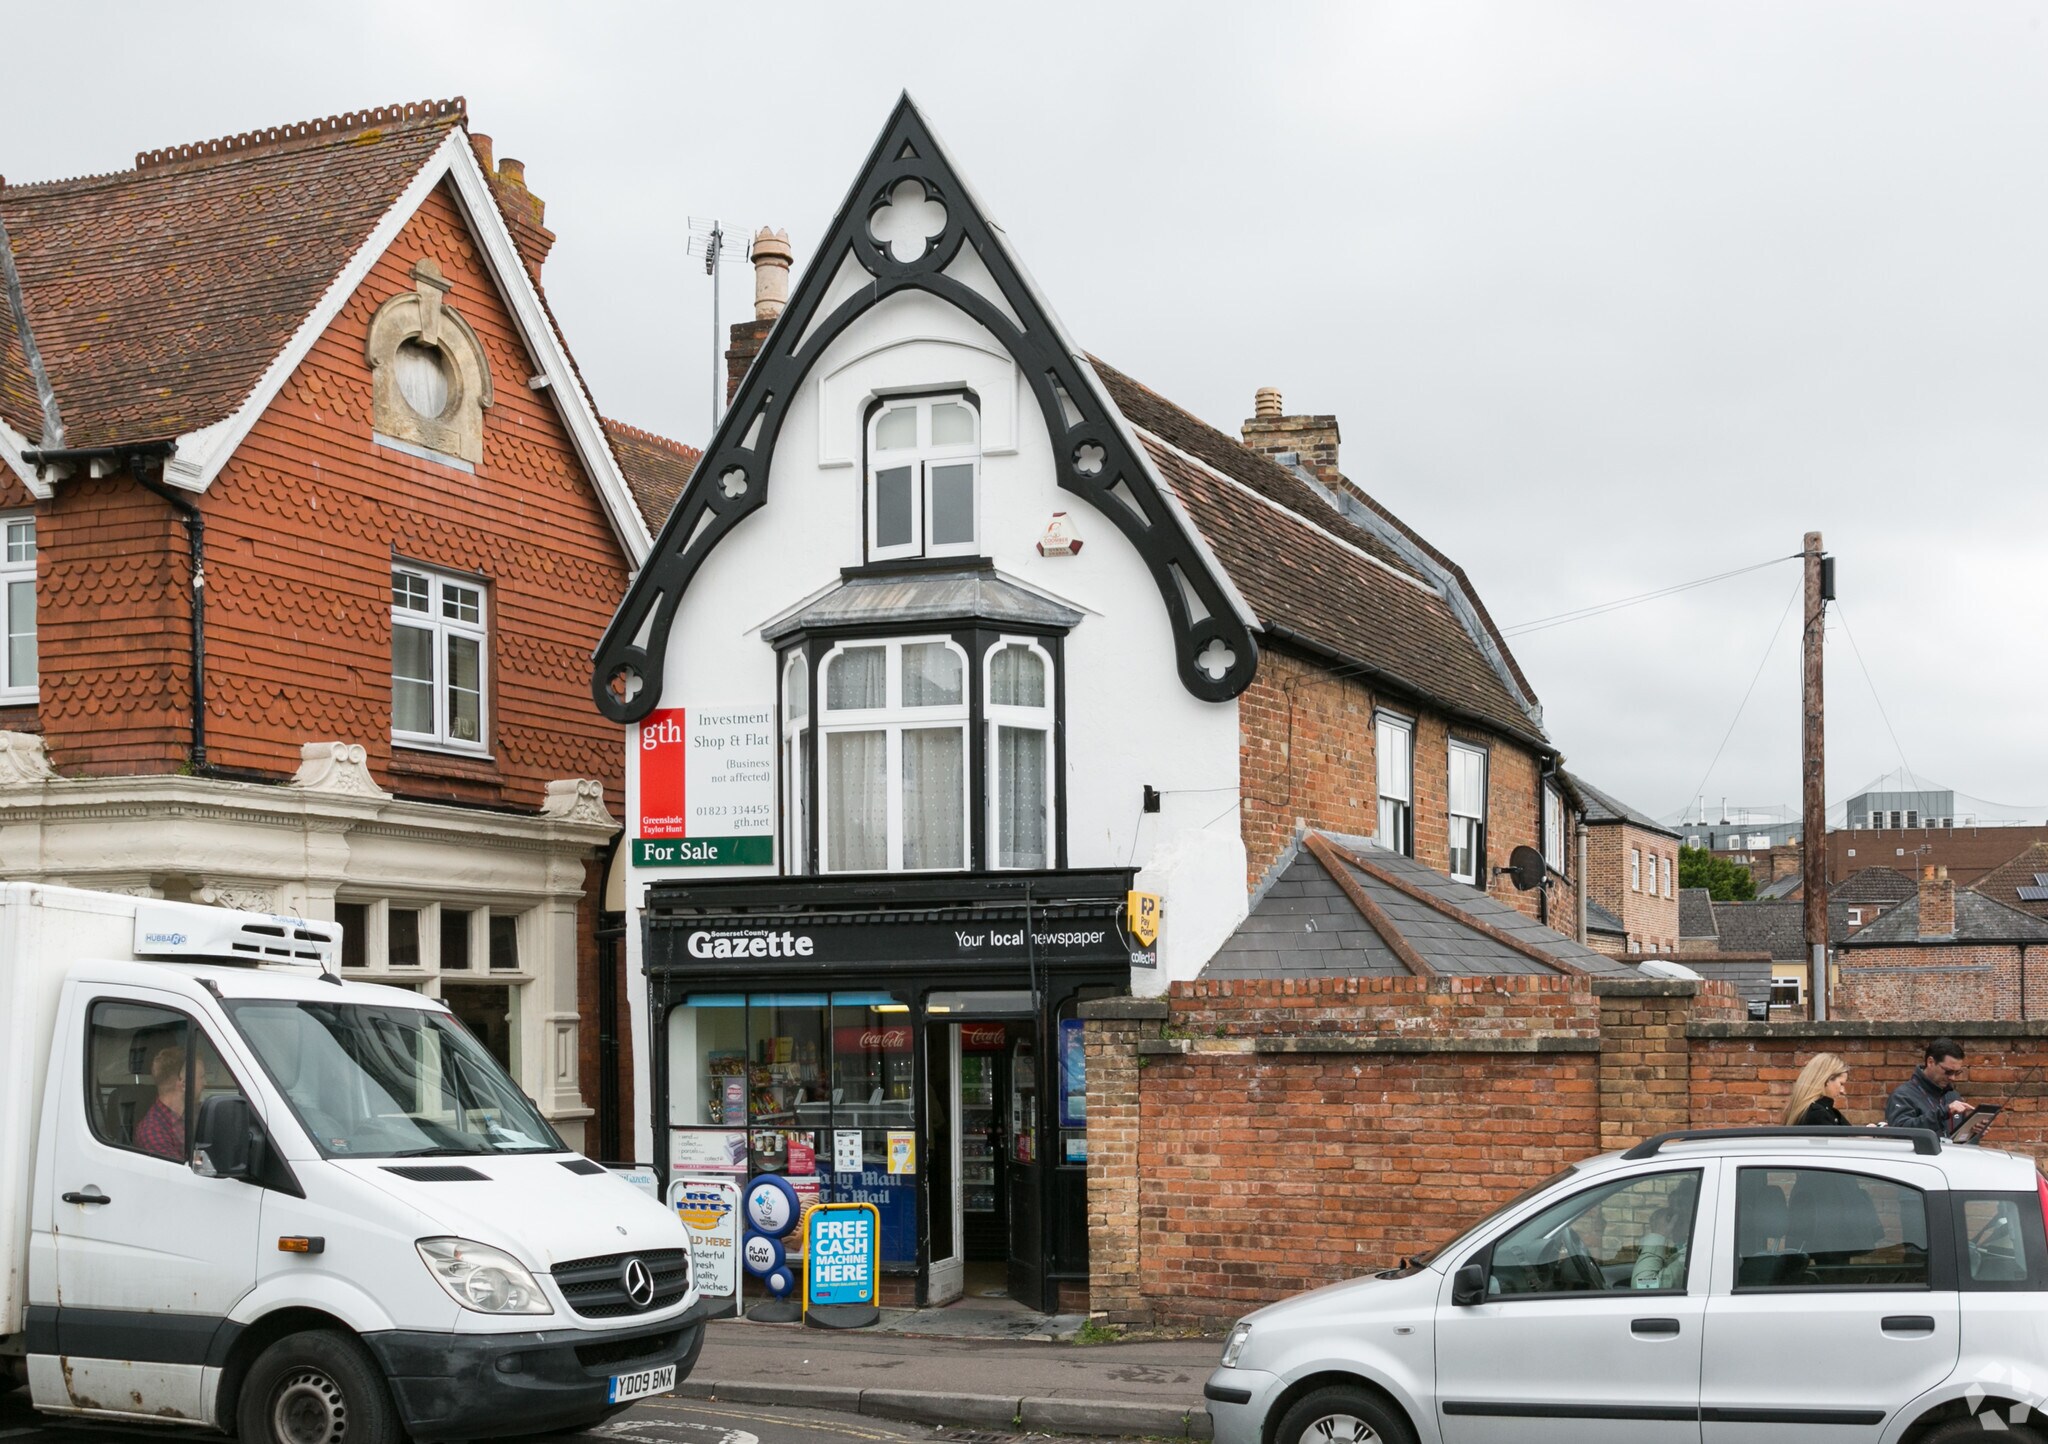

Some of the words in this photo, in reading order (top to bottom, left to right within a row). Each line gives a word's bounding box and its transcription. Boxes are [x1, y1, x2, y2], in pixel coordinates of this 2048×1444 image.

[699, 713, 769, 726] Investment
[642, 718, 682, 750] gth
[694, 736, 725, 750] Shop
[730, 735, 740, 746] &
[745, 734, 769, 746] Flat
[726, 759, 770, 770] (Business
[711, 774, 726, 783] not
[730, 772, 770, 783] affected)
[696, 806, 727, 816] 01823
[732, 805, 770, 815] 334455
[642, 816, 682, 824] Greenslade
[734, 818, 769, 829] gth.net
[644, 826, 665, 834] Taylor
[666, 825, 682, 833] Hunt
[644, 844, 674, 860] For
[680, 842, 718, 860] Sale
[1140, 916, 1150, 928] Pay
[710, 930, 744, 938] Somerset
[1140, 926, 1154, 937] Point
[146, 933, 187, 945] HUBBARD
[687, 930, 814, 959] Gazette
[955, 931, 985, 947] Your
[990, 930, 1024, 946] local
[1030, 931, 1105, 948] newspaper
[861, 1172, 902, 1186] Mail
[686, 1192, 721, 1201] BIG
[852, 1190, 890, 1204] Mail
[676, 1202, 733, 1212] BITES
[816, 1220, 868, 1239] FREE
[705, 1236, 732, 1248] HERE
[816, 1238, 868, 1255] CASH
[749, 1246, 769, 1255] PLAY
[749, 1254, 769, 1263] NOW
[816, 1254, 868, 1265] MACHINE
[816, 1264, 868, 1282] HERE
[619, 1372, 650, 1396] YD09
[652, 1367, 674, 1390] BNX
